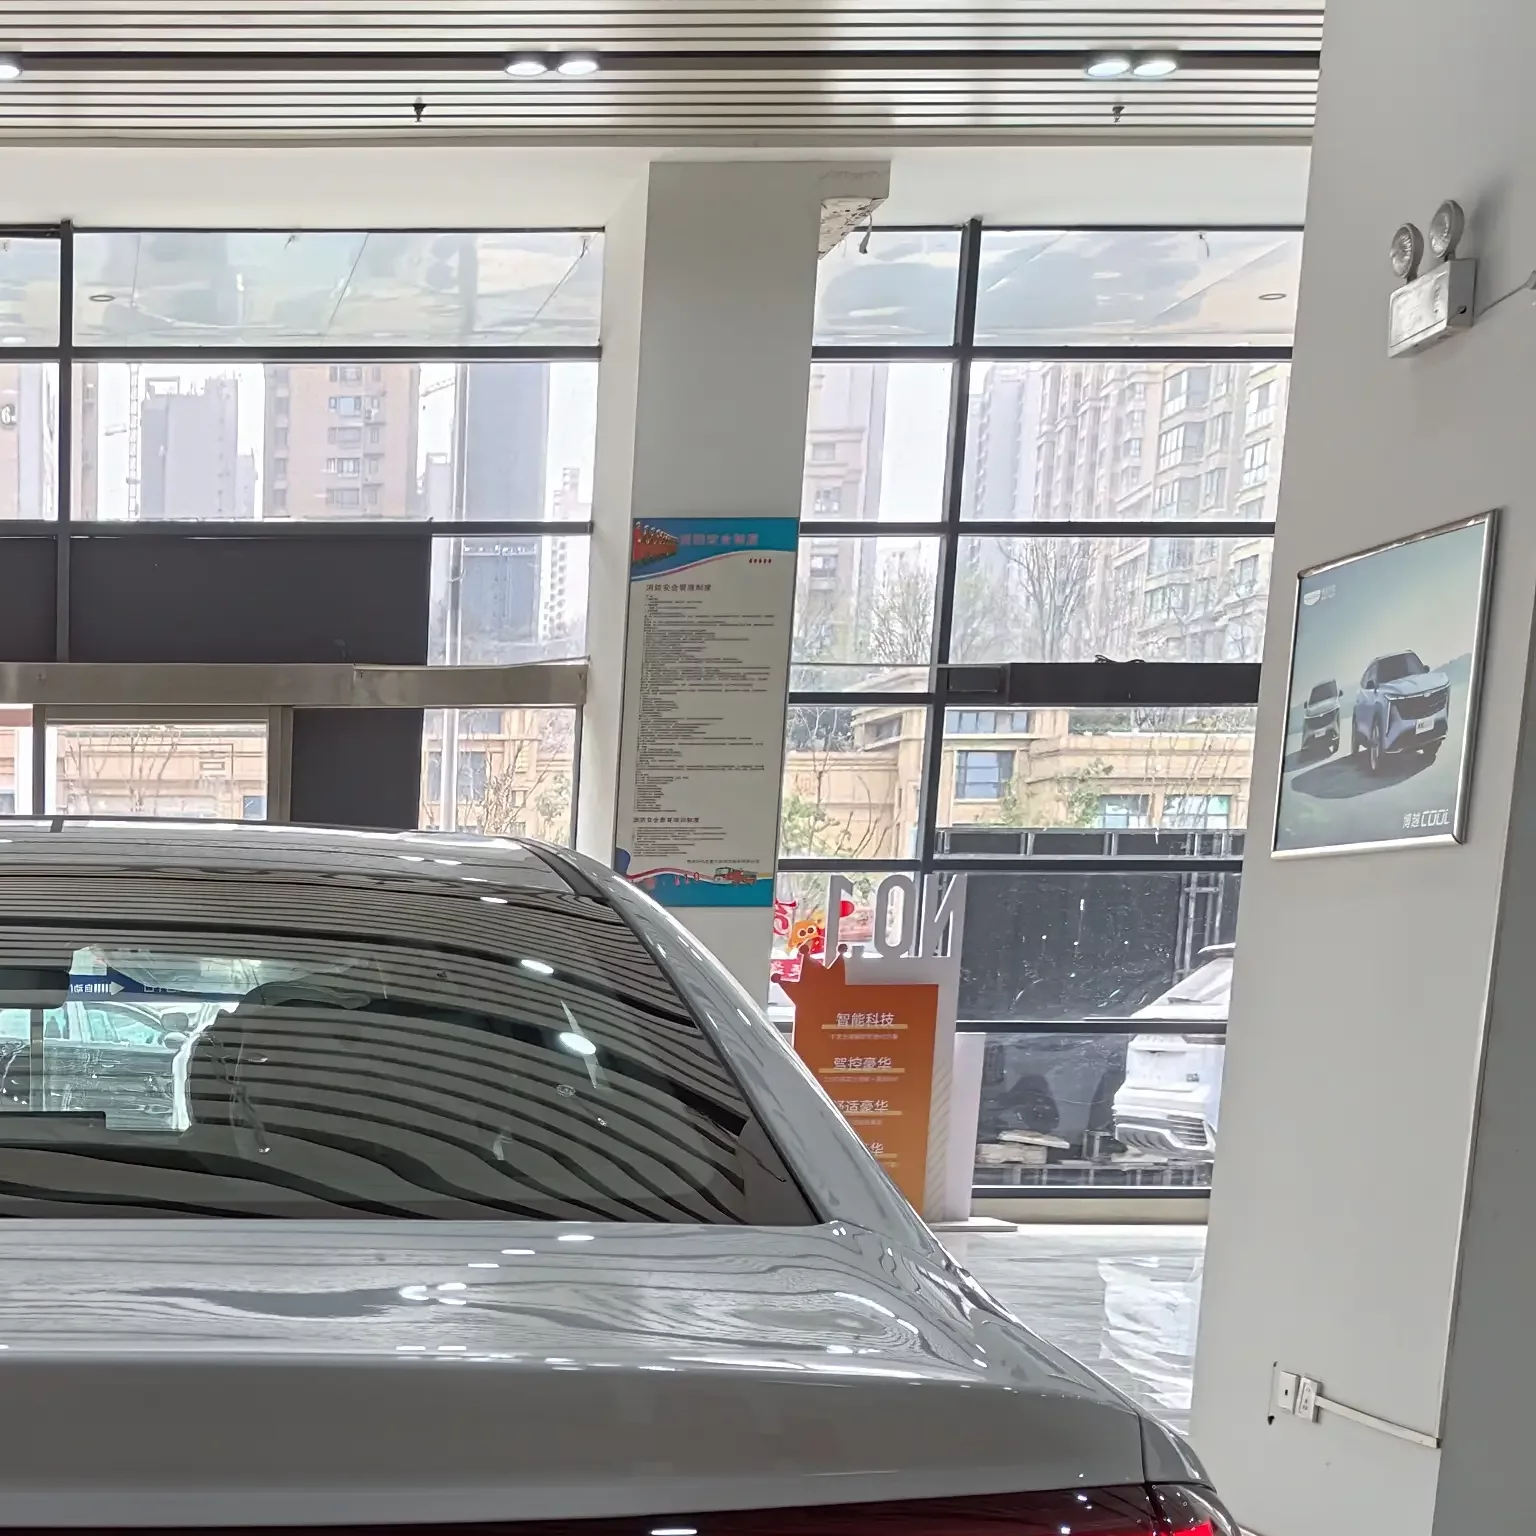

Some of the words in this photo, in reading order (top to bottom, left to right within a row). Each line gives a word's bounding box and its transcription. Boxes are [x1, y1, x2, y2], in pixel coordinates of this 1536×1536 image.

[836, 1012, 894, 1027] 智能科技
[834, 1057, 892, 1071] 驾控豪华
